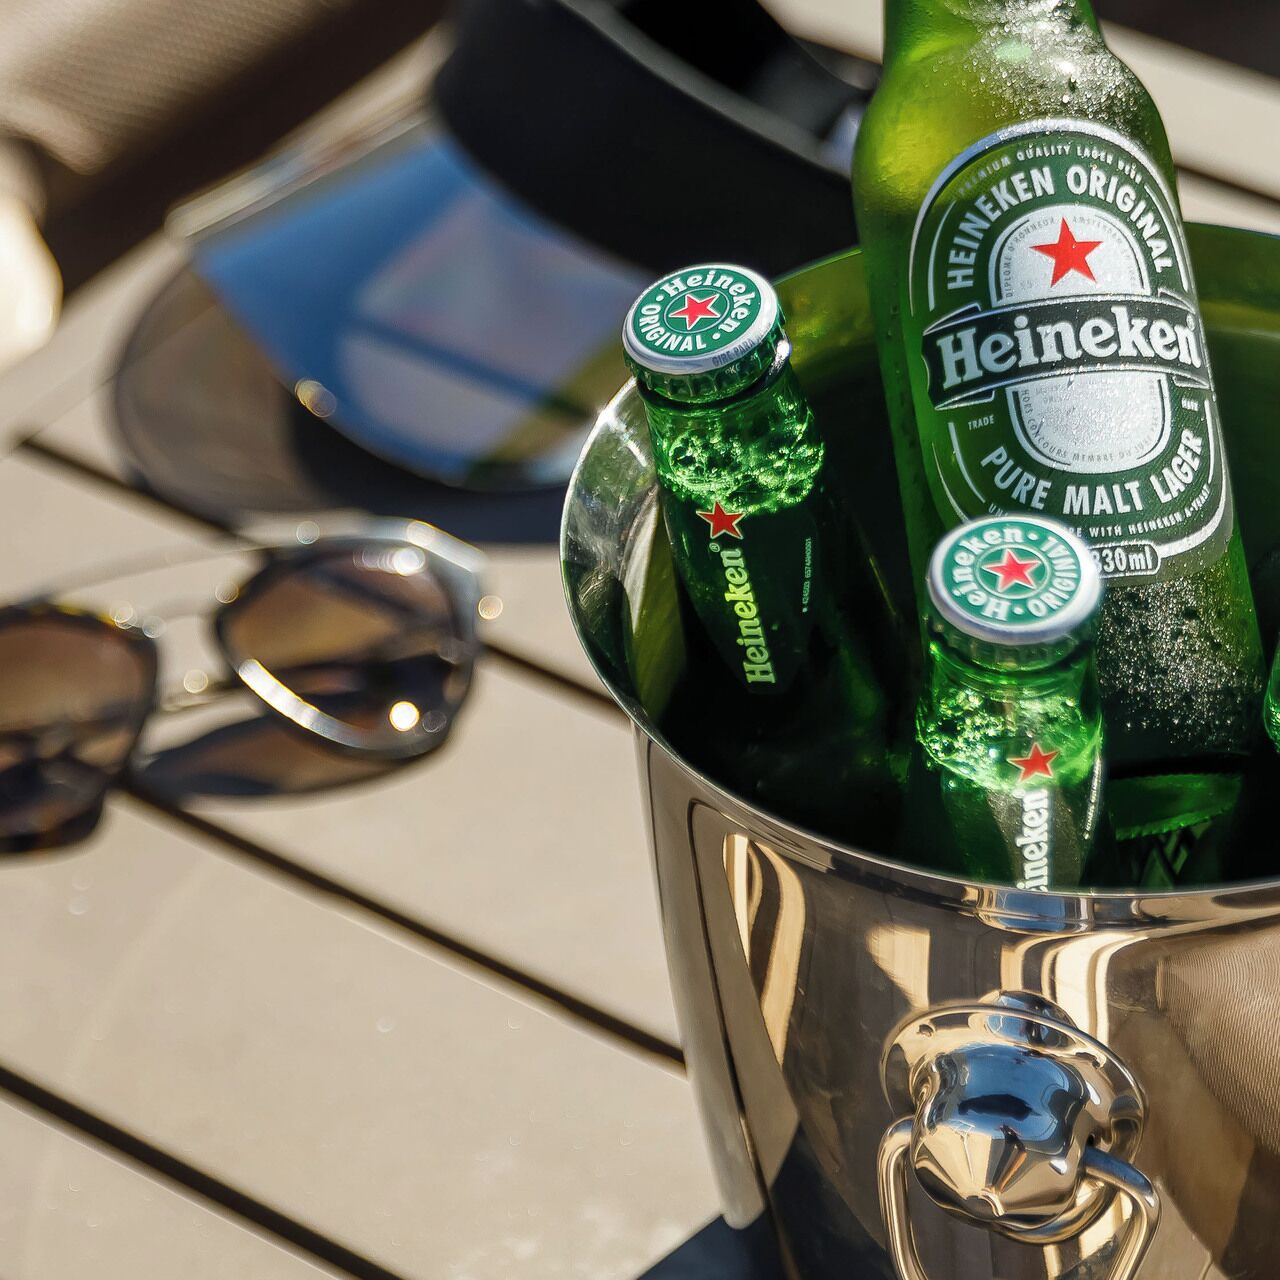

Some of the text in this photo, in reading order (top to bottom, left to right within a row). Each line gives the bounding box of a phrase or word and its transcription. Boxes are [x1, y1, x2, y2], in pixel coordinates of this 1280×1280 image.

[1016, 143, 1071, 161] QUALITY
[1077, 145, 1114, 165] LAGER
[947, 164, 1174, 290] HEINEKEN ORIGINAL
[639, 304, 707, 352] ORIGINAL
[660, 270, 756, 333] Heineken
[936, 305, 1202, 390] Heineken
[968, 414, 995, 431] TRADE
[980, 428, 1203, 516] PURE MALT LAGER
[1089, 525, 1123, 538] WITH
[1128, 511, 1183, 535] HEINEKEN
[951, 525, 1024, 621] Heineken
[1026, 536, 1078, 617] ORIGINAL
[720, 547, 776, 684] Heineken
